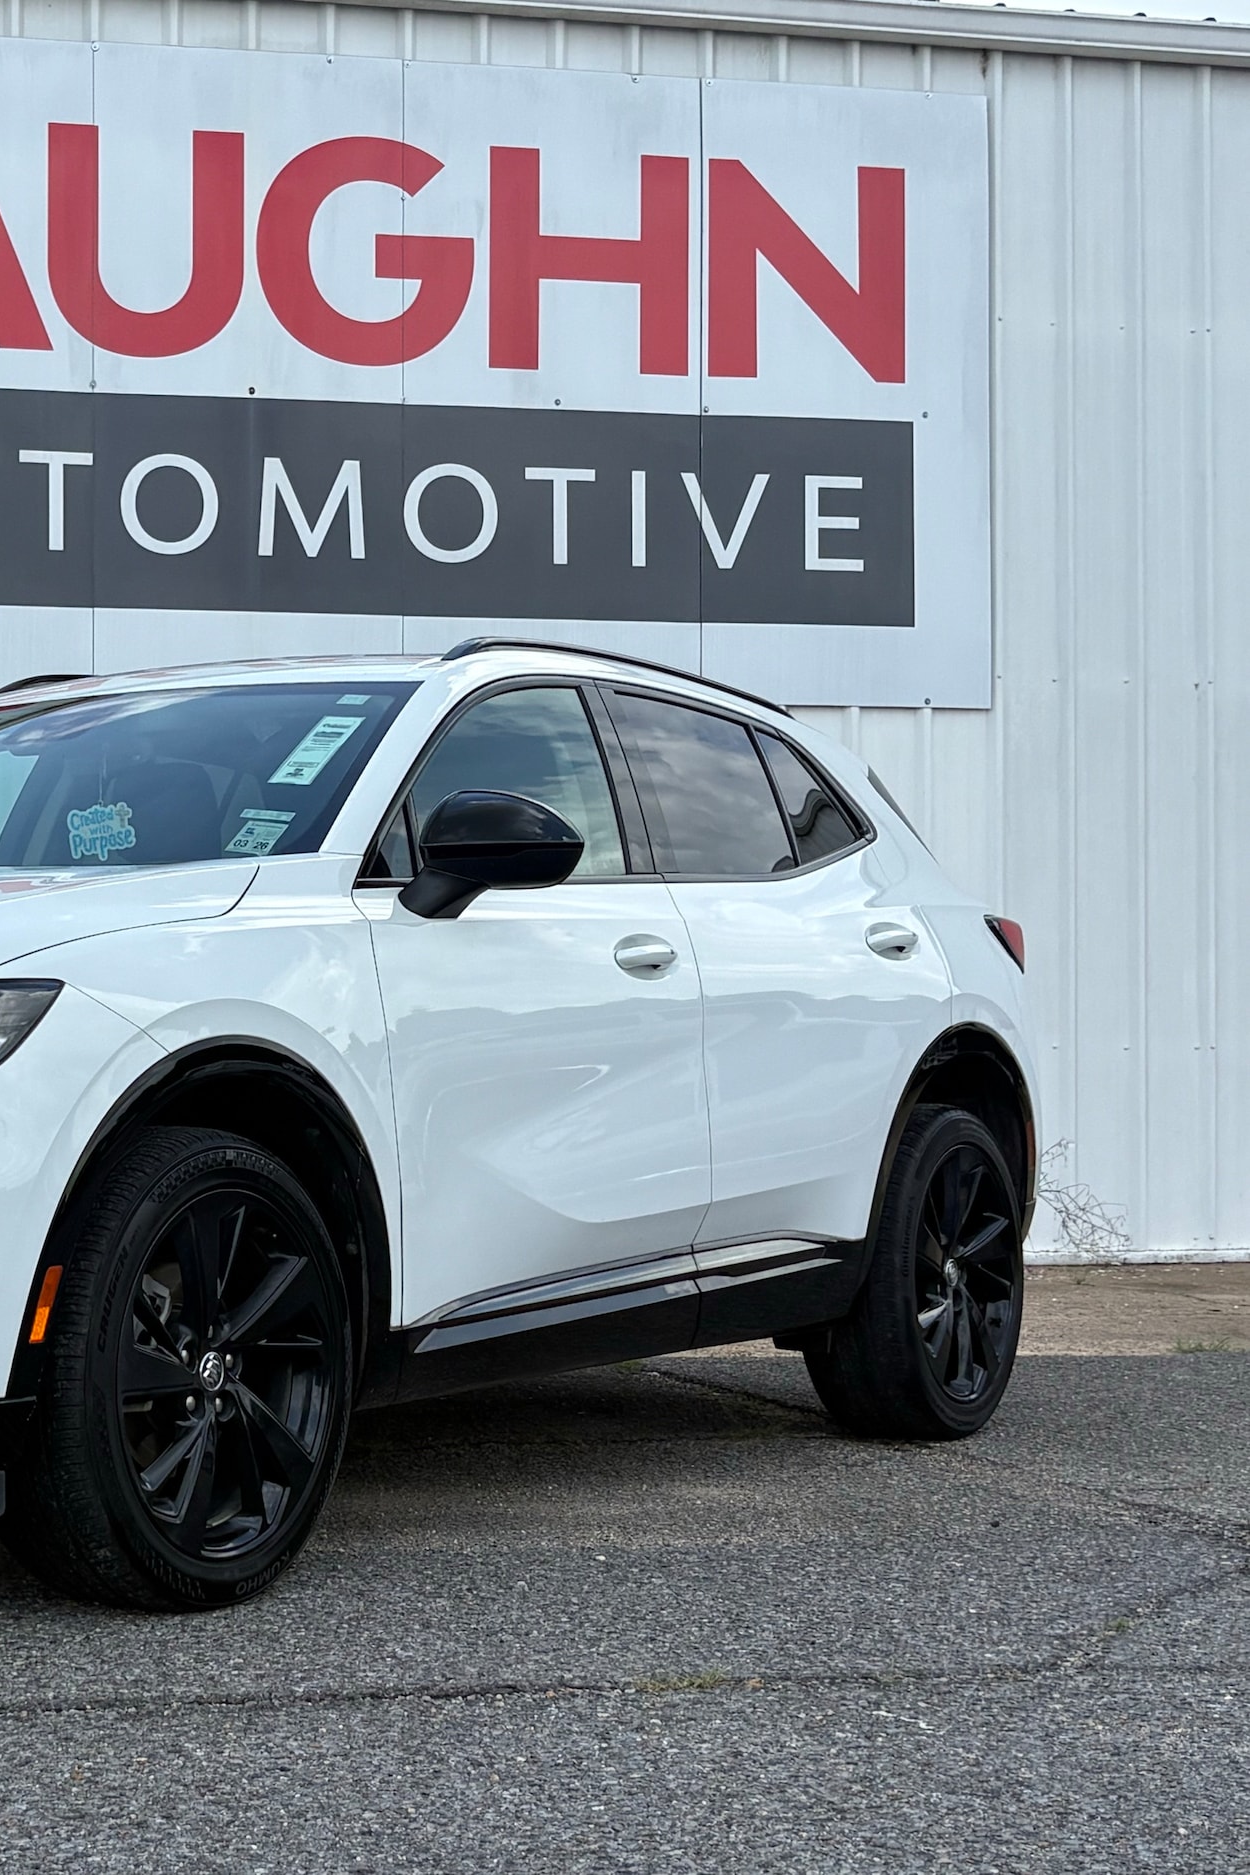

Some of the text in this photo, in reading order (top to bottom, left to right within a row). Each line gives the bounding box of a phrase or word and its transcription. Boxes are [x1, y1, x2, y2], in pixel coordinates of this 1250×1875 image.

[70, 808, 114, 831] Created
[89, 824, 114, 840] with
[71, 829, 132, 859] Purpose
[233, 839, 269, 850] 03 26
[235, 1550, 290, 1595] KUMHO
